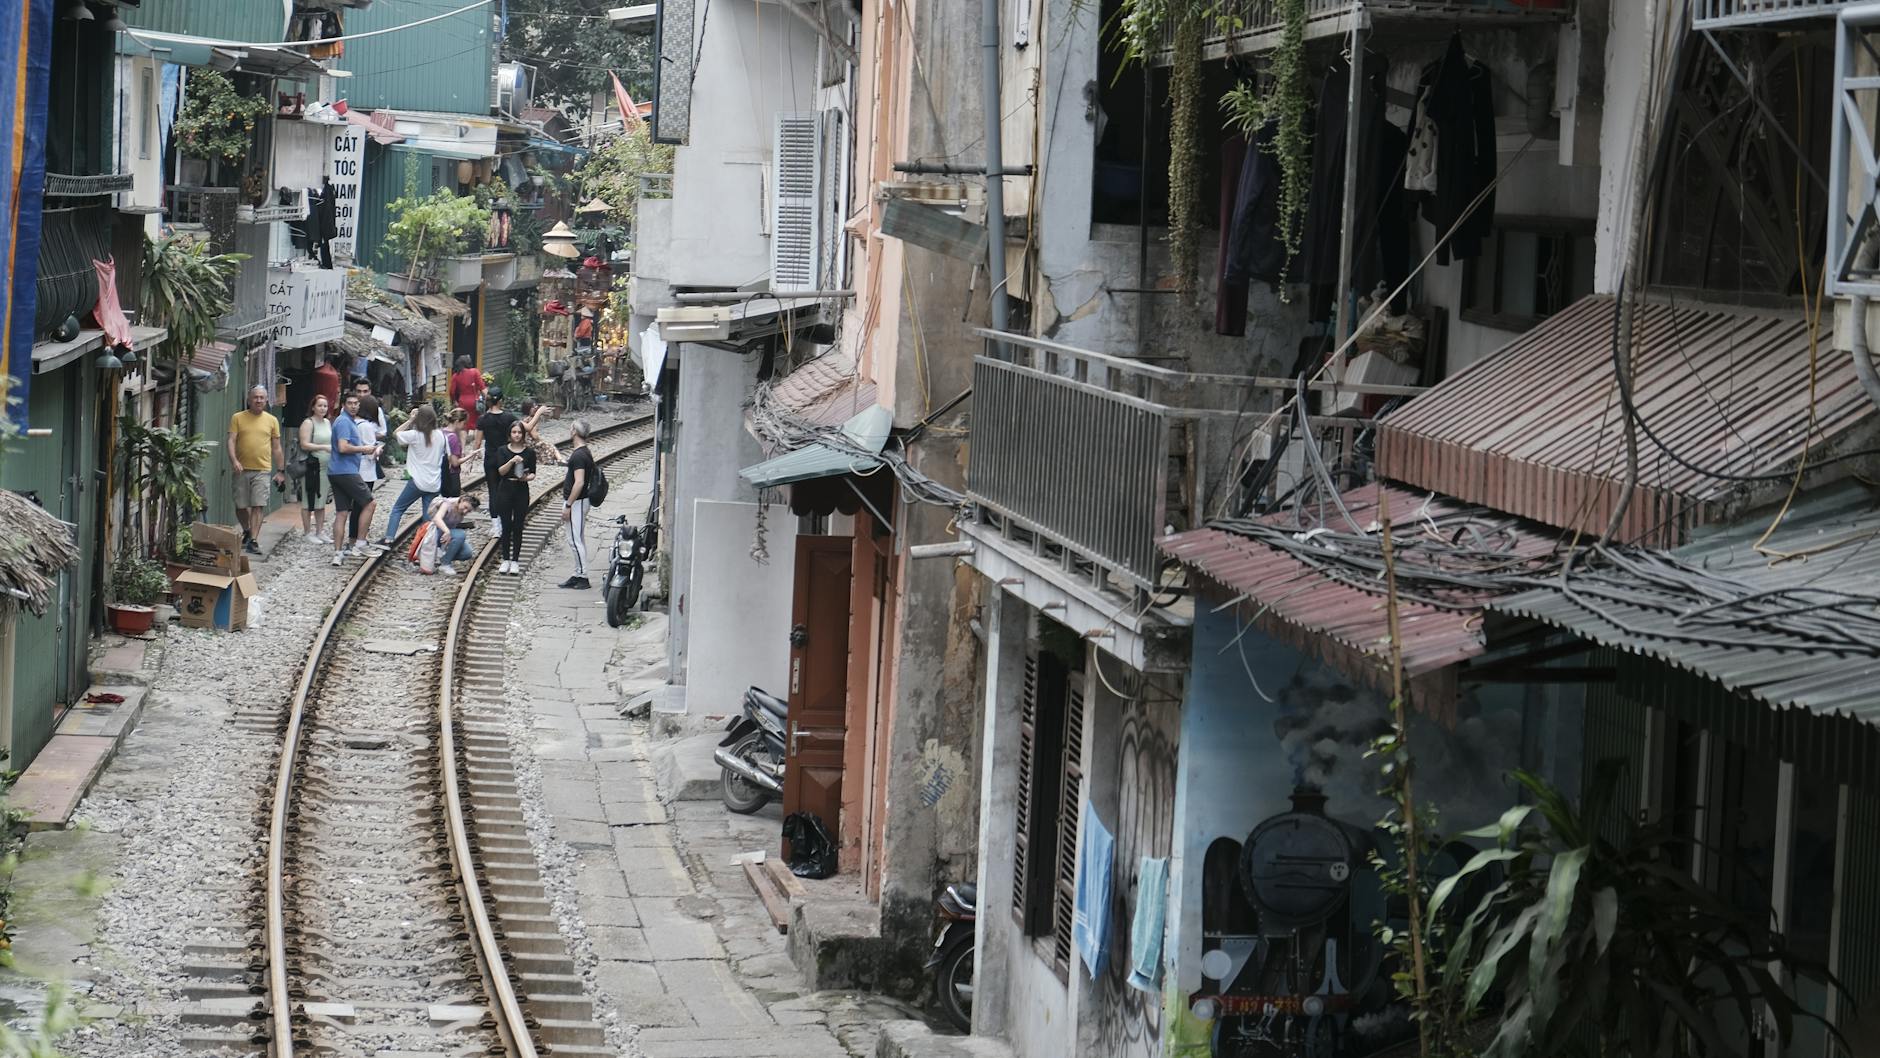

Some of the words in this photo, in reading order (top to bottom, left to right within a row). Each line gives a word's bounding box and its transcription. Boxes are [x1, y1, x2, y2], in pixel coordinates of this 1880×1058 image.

[334, 130, 358, 153] CẮT
[334, 156, 356, 176] TÓC
[269, 280, 294, 297] CẮT
[269, 302, 292, 317] TÓC
